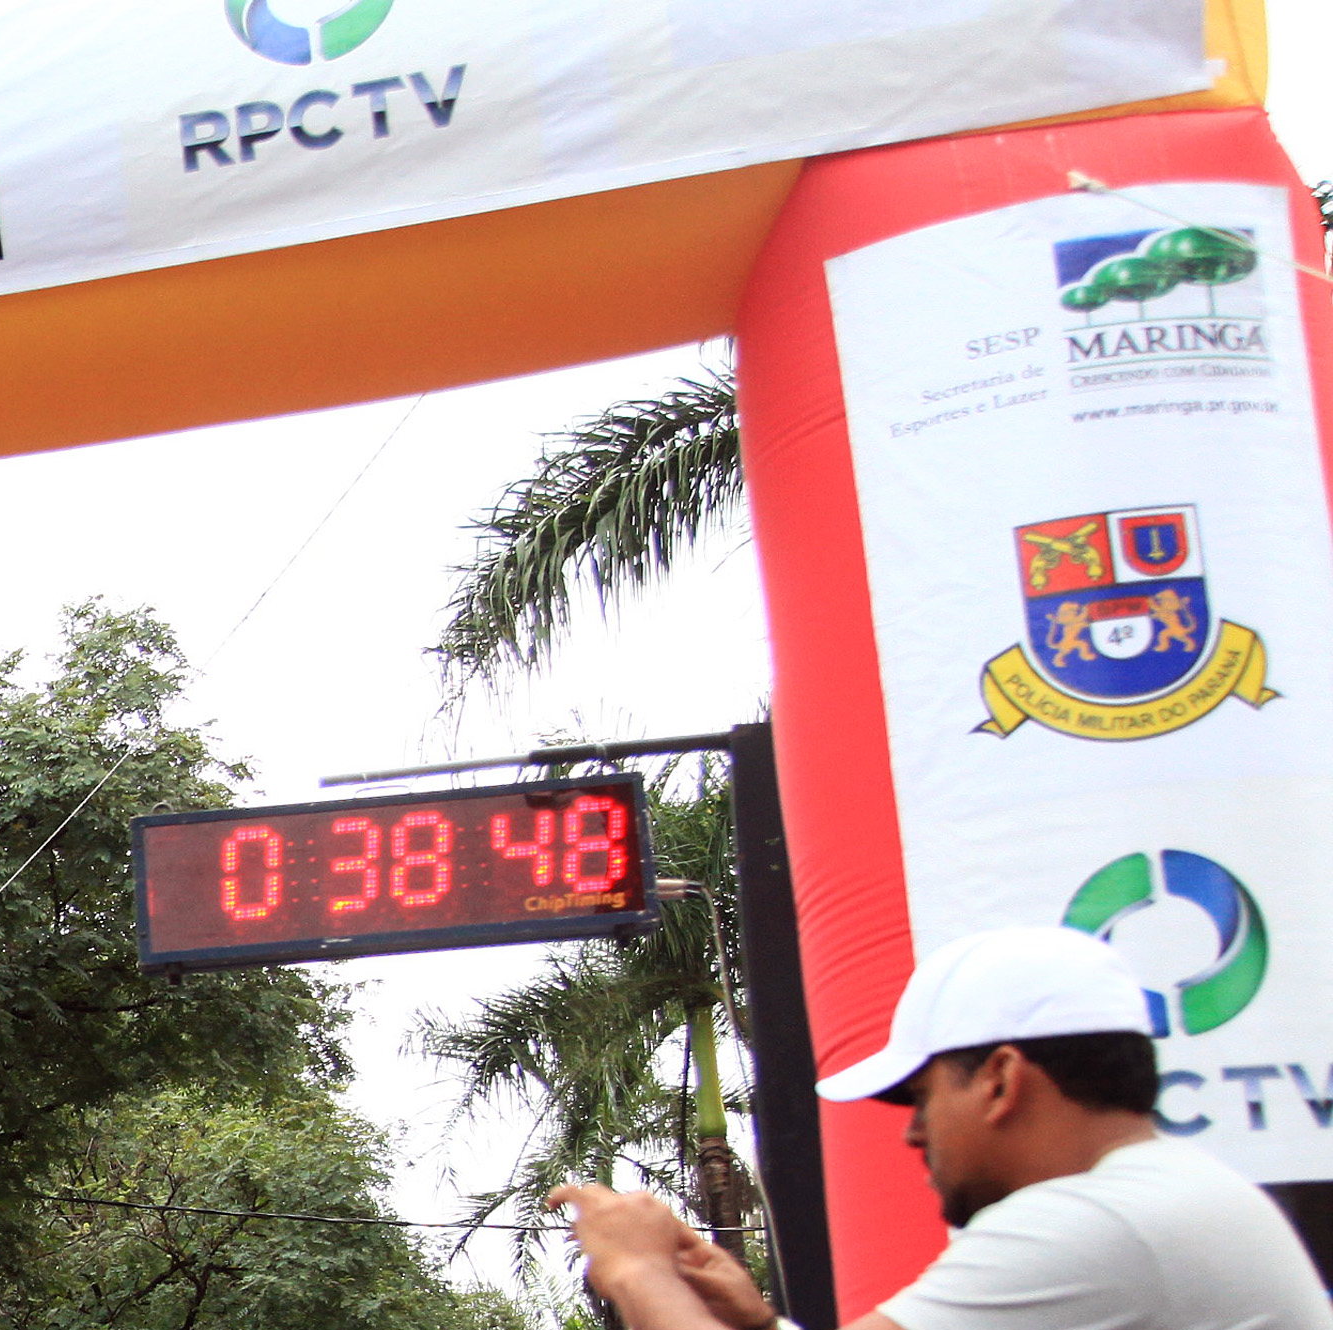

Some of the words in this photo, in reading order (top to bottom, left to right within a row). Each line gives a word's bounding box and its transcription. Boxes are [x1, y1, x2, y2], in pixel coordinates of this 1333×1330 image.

[965, 325, 1041, 361] SESP
[921, 371, 1015, 405] Secretaria
[1021, 363, 1046, 380] de
[992, 388, 1048, 410] Lazer
[1077, 712, 1156, 731] MILITAR
[1159, 702, 1187, 724] DO
[524, 891, 627, 915] ChipTiming
